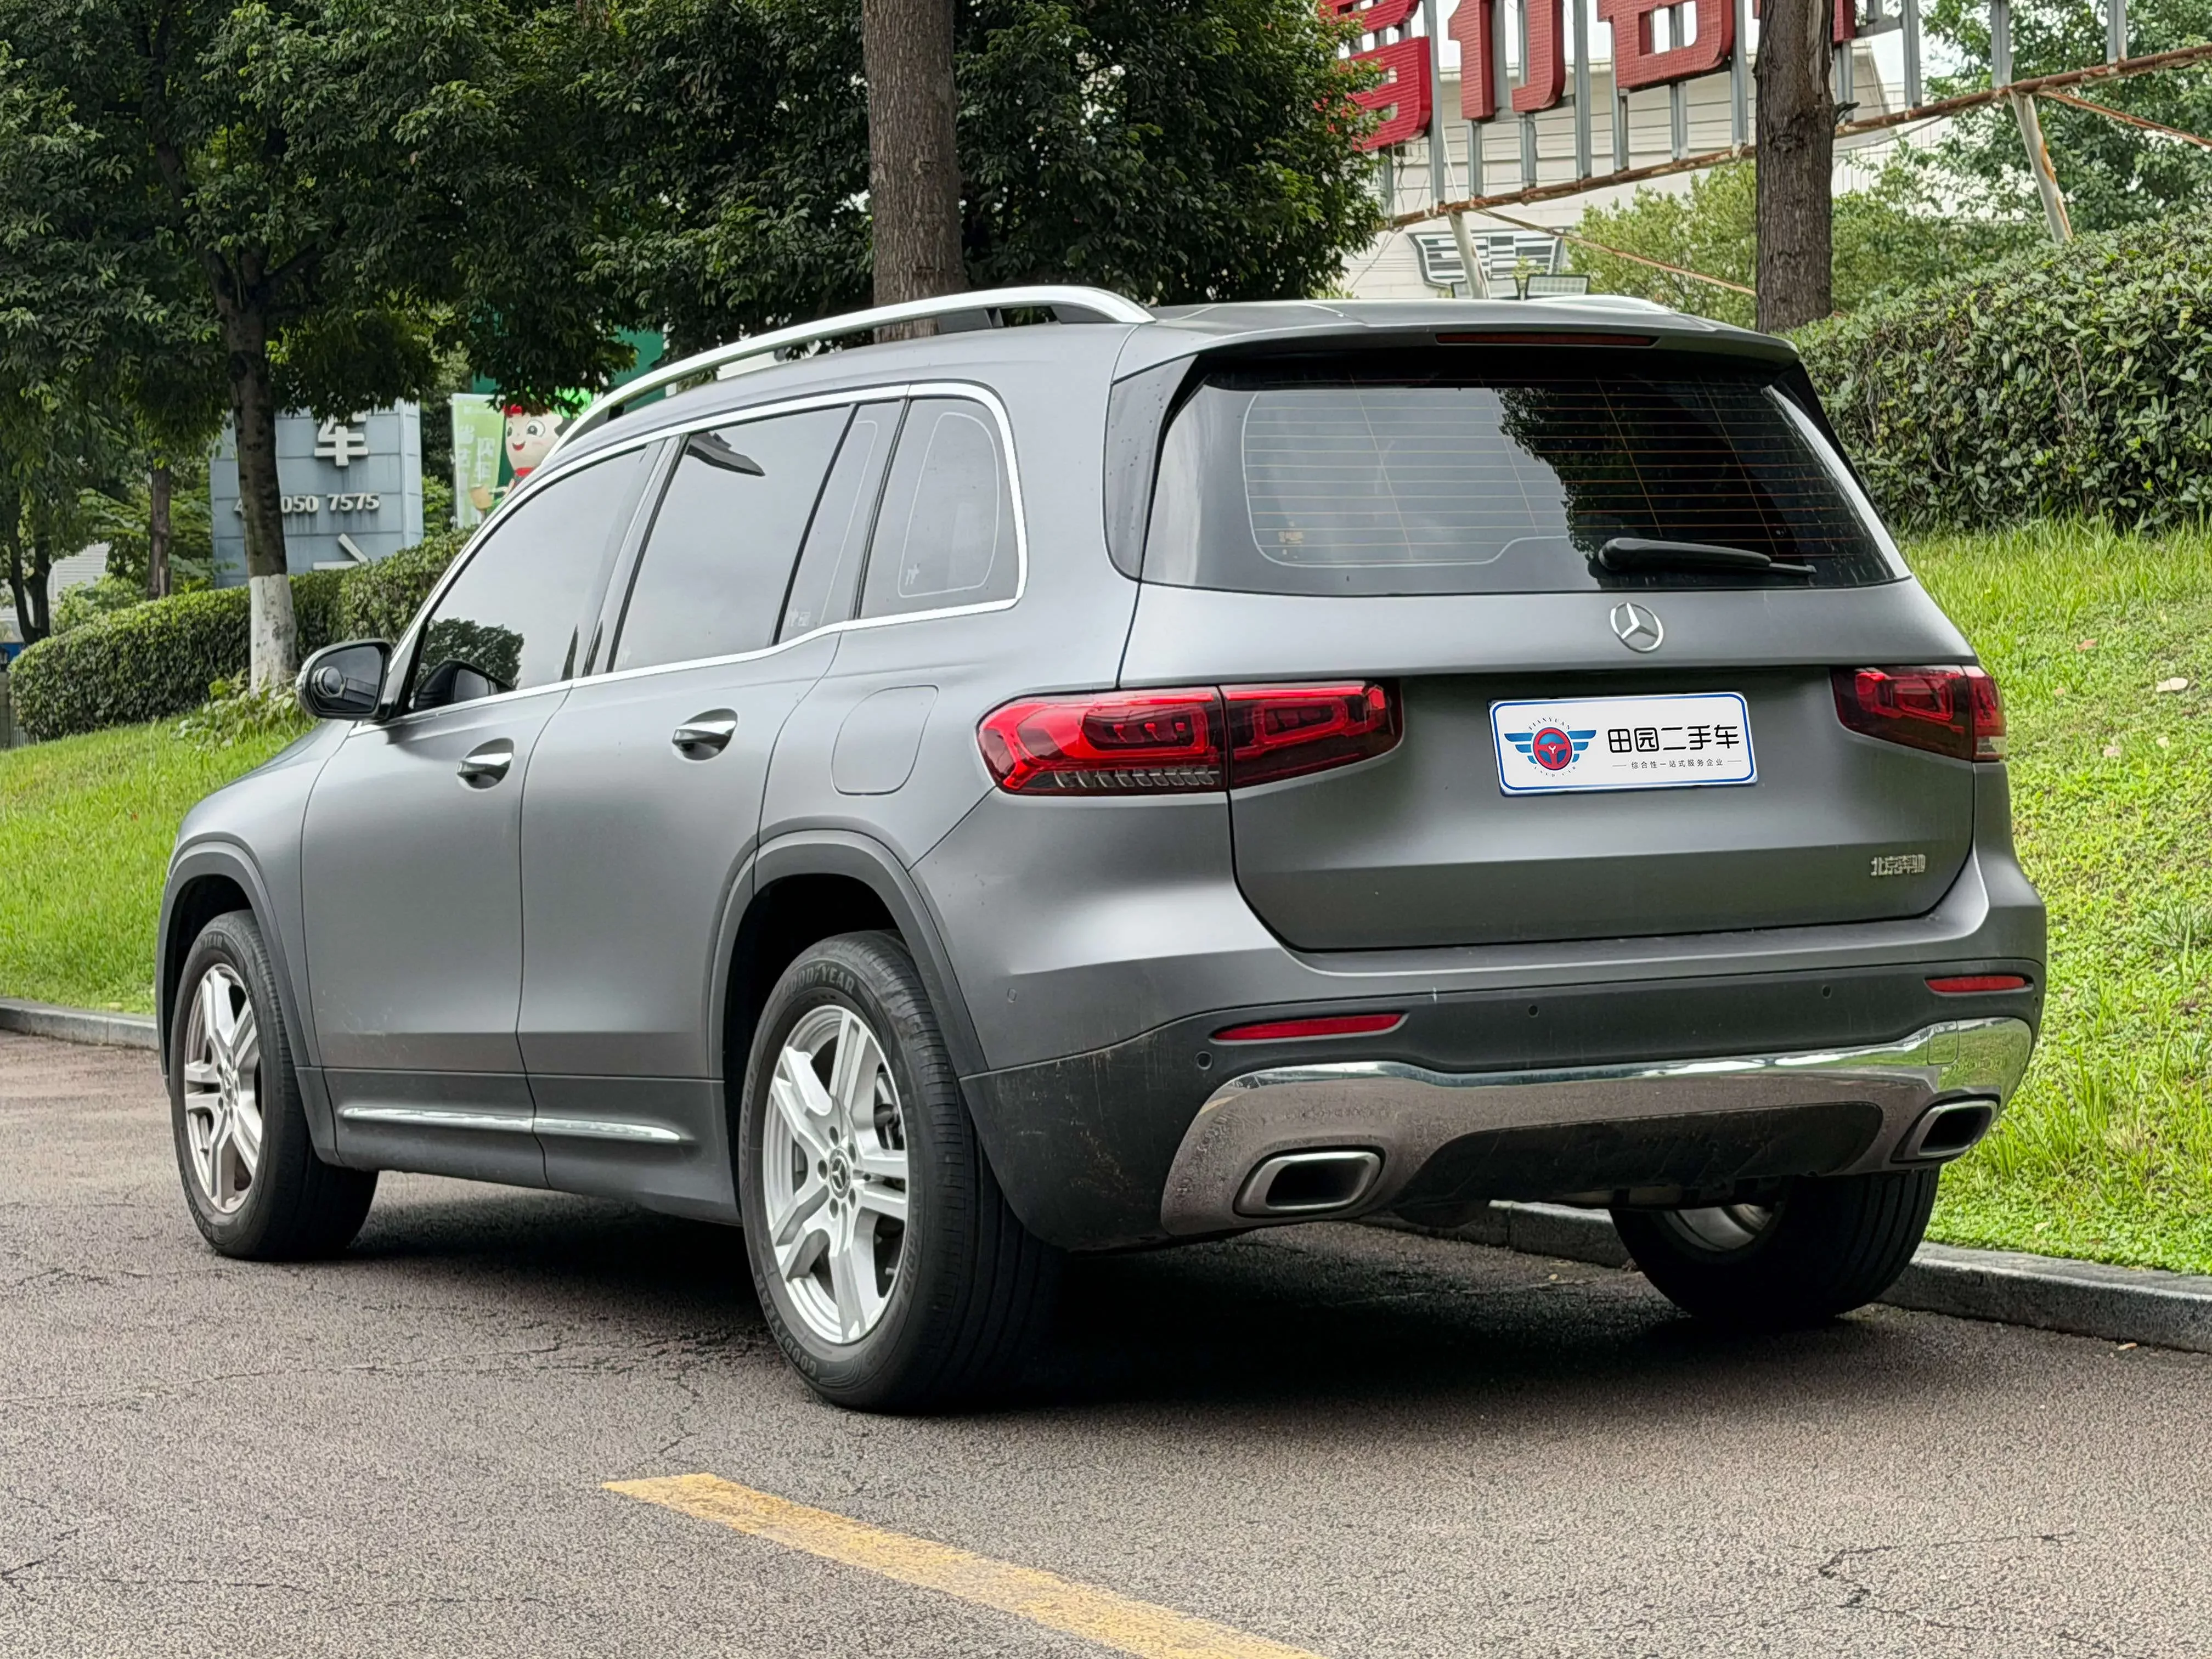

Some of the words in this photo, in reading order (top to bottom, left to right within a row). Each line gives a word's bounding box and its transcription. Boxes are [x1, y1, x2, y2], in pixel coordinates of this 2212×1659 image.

[280, 495, 320, 514] 050
[326, 493, 381, 511] 7575
[1607, 725, 1740, 753] 田园二手车
[1631, 758, 1723, 769] 综合性一站式服务企业
